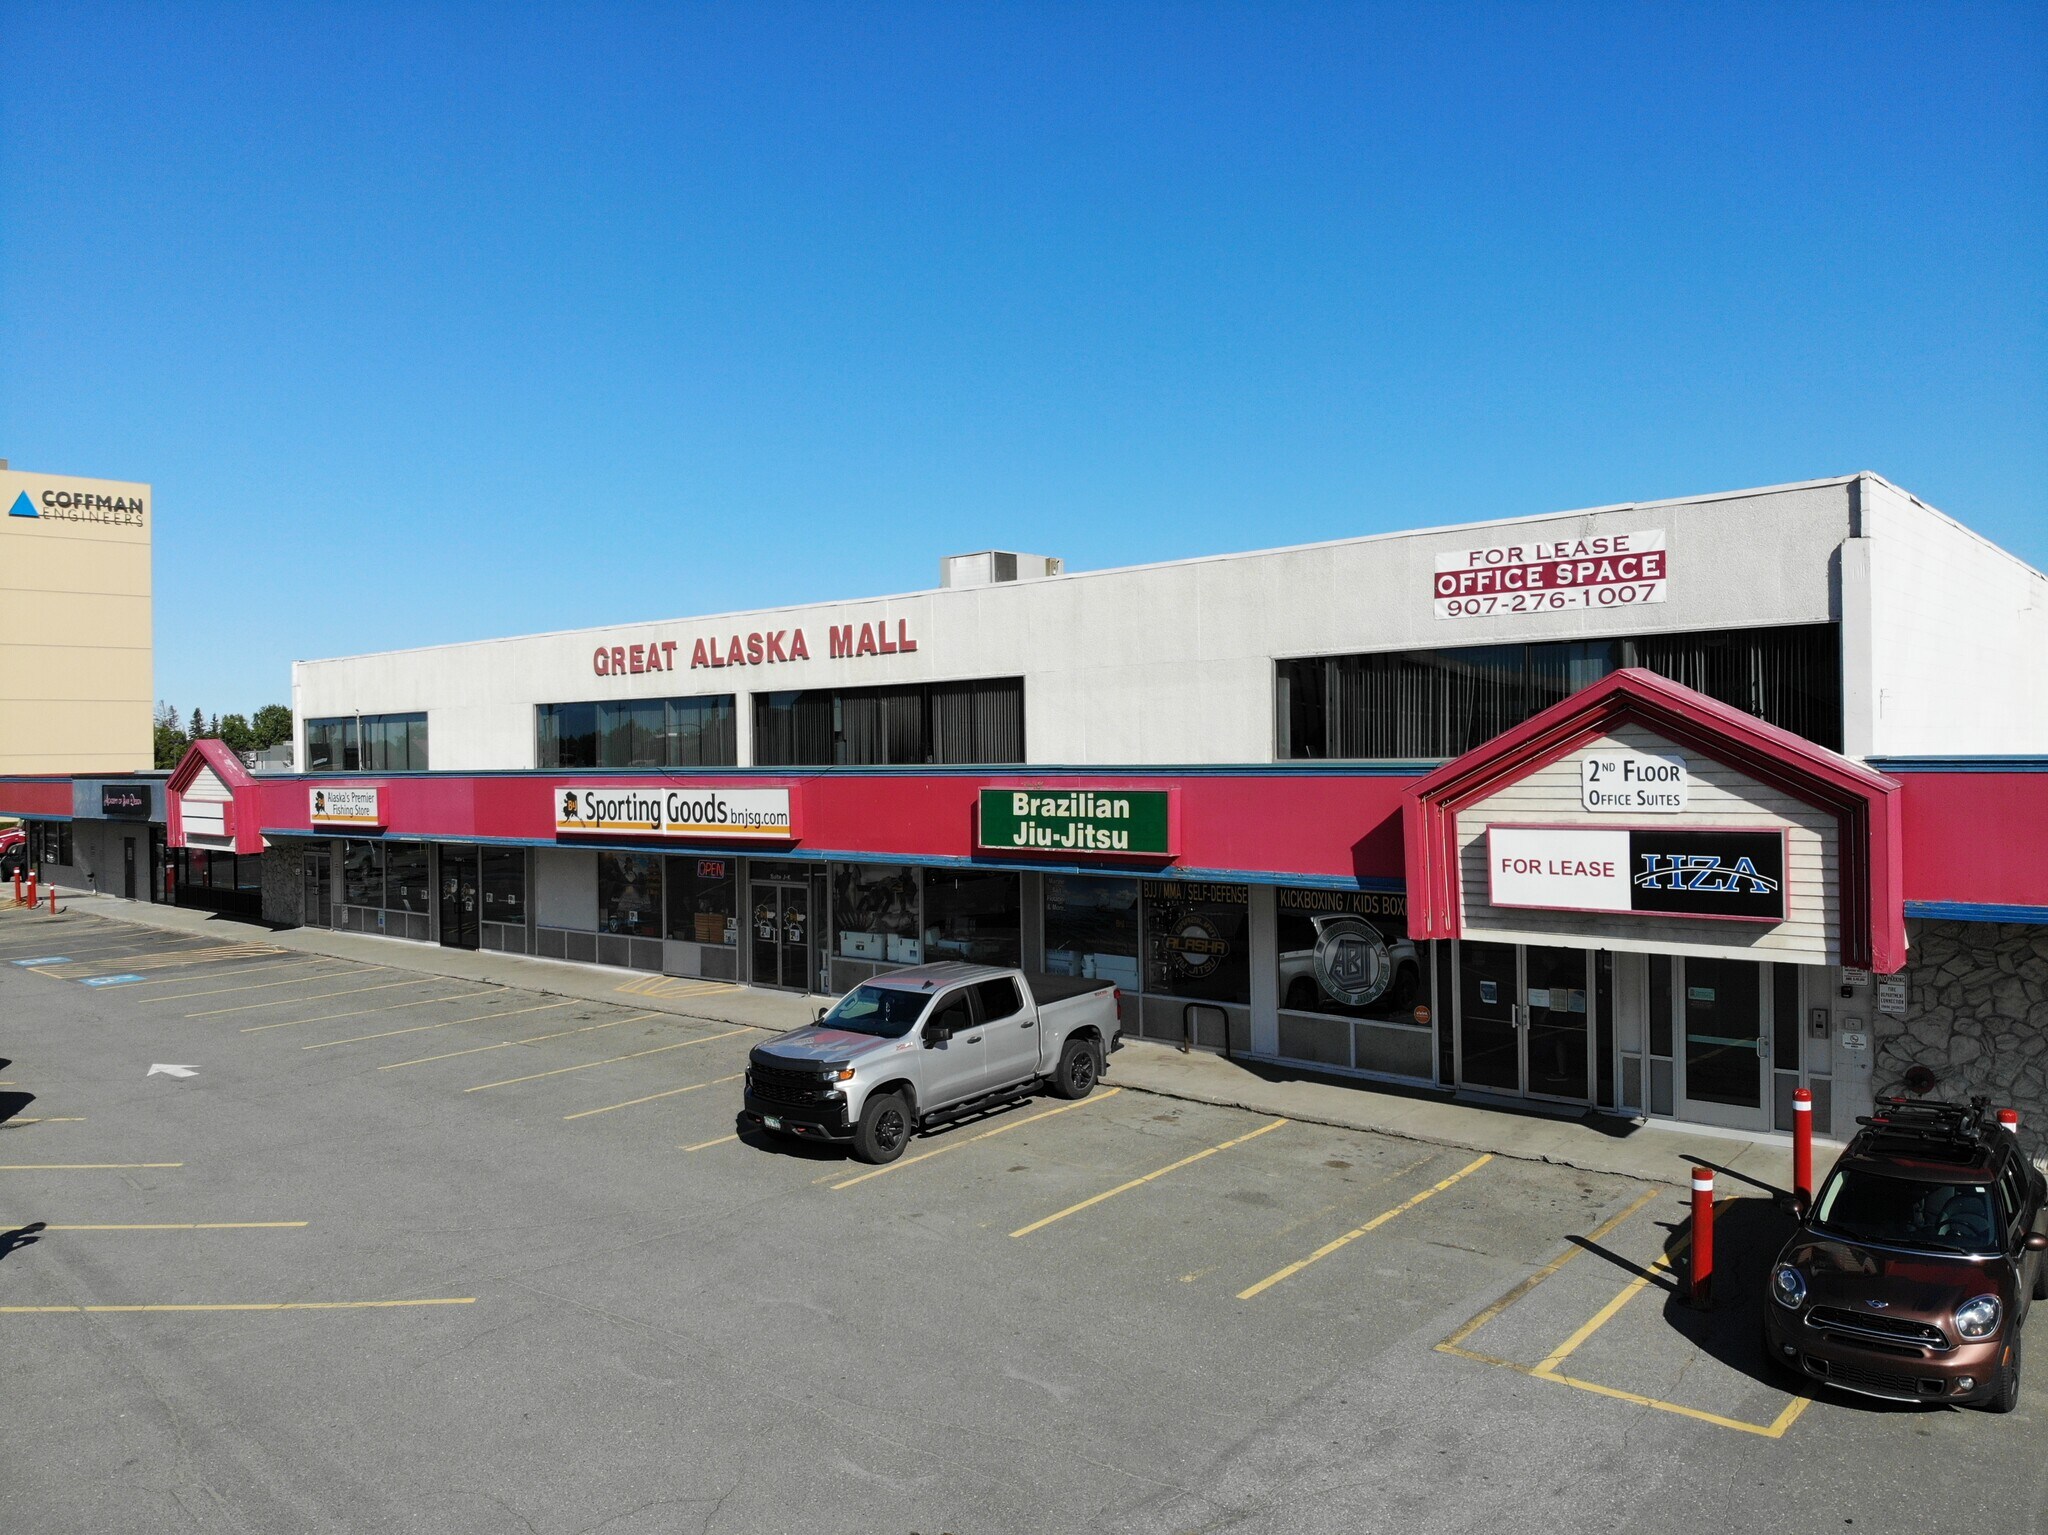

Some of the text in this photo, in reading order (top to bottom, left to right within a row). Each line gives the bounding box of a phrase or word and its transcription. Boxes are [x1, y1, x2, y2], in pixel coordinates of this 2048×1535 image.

[42, 490, 143, 514] COFFMAN
[43, 507, 143, 527] ENGINEERS
[1469, 535, 1630, 567] FOR LEASE
[1437, 554, 1660, 595] OFFICE SPACE
[1447, 584, 1656, 616] 907-276-1007
[593, 618, 918, 676] GREAT ALASKA MALL
[327, 792, 374, 803] Alaska's Premier
[1012, 793, 1130, 818] Brazilian
[333, 804, 370, 818] Fishing Store
[586, 791, 788, 830] Sporting Goods bnjsg.com
[1013, 821, 1129, 849] Jiu-Jitsu
[699, 861, 724, 876] OPEN
[1502, 858, 1615, 877] FOR LEASE
[1637, 854, 1776, 893] HZA
[1143, 881, 1157, 898] BJJ
[1163, 883, 1182, 899] MMA
[1187, 883, 1248, 904] SELF-DEFENSE
[1280, 889, 1344, 912] KICKBOXING
[1353, 894, 1379, 914] KIDS
[1879, 974, 1887, 983] NO
